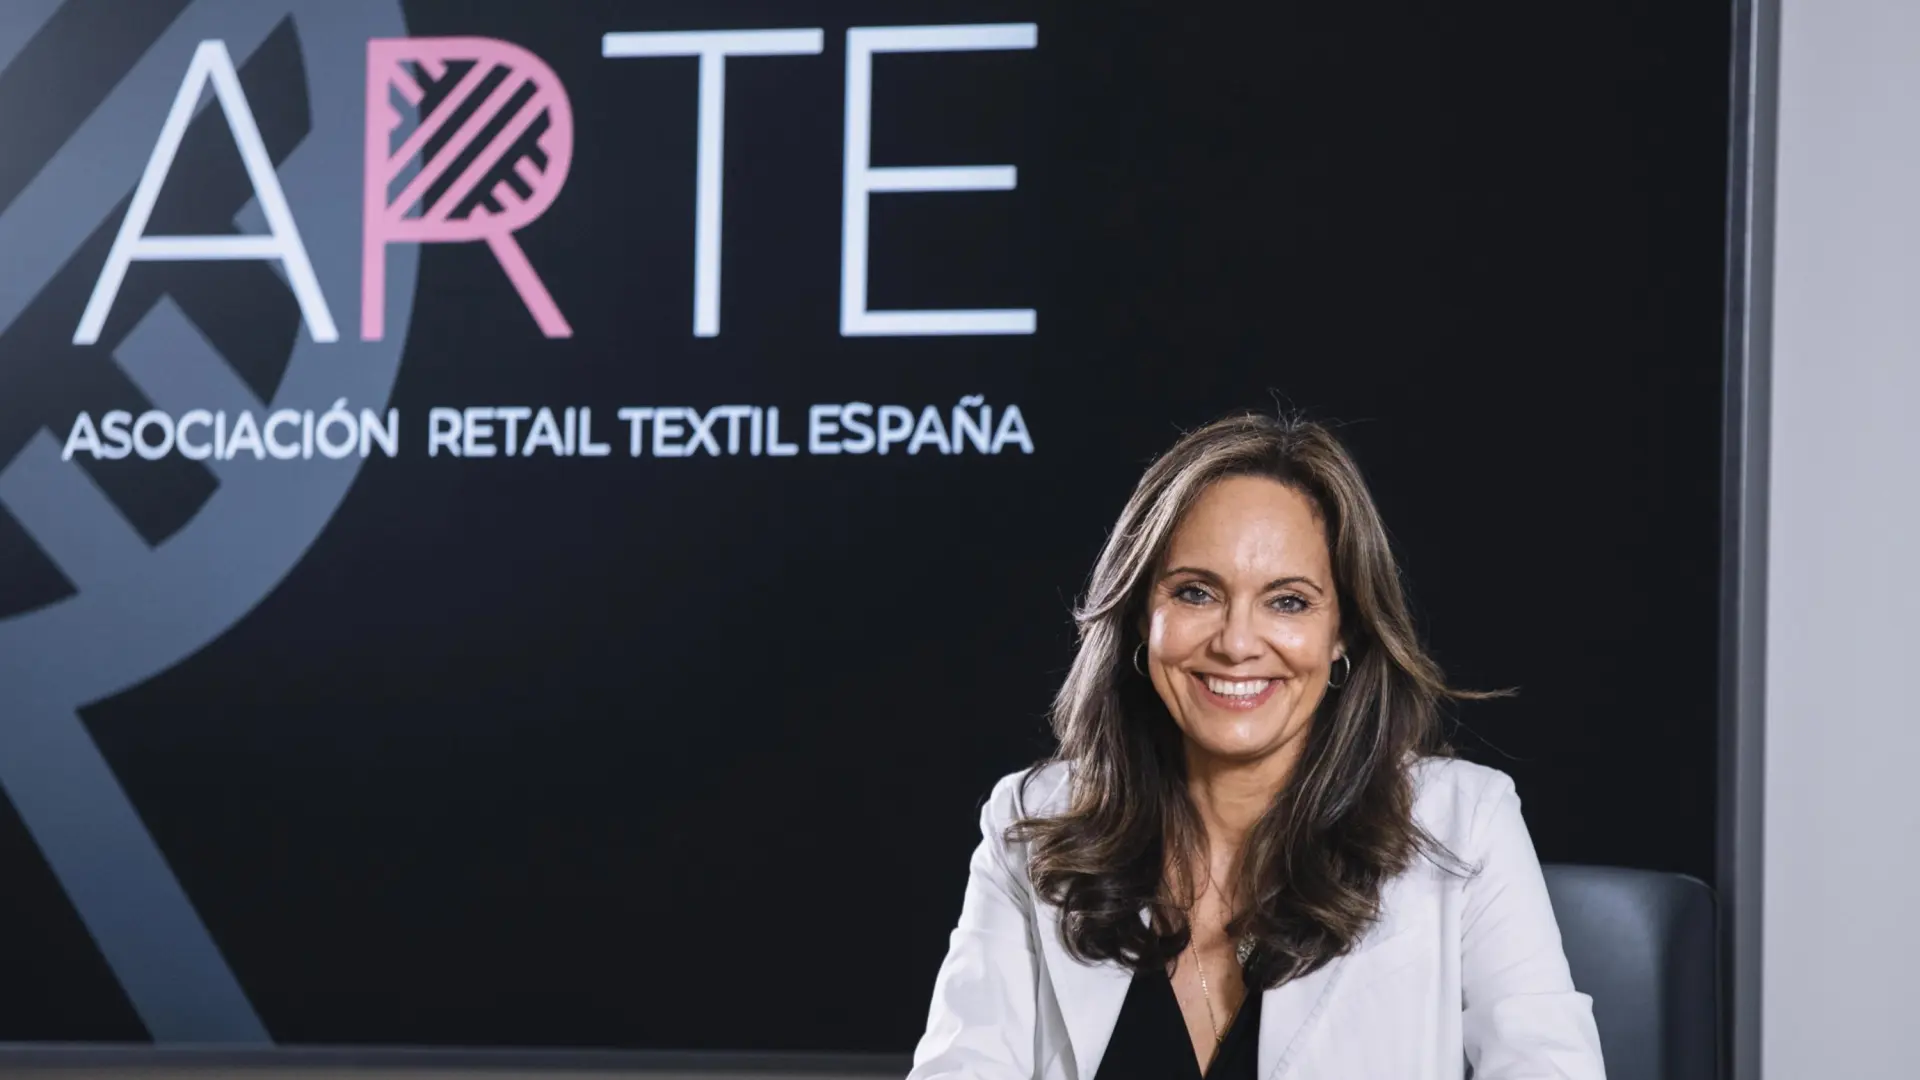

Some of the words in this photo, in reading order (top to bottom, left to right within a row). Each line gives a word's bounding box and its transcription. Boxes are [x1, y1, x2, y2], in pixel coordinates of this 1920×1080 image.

[72, 22, 1038, 345] ARTE
[62, 397, 399, 461] ASOCIACIÓN
[428, 408, 610, 457] RETAIL
[619, 407, 799, 457] TEXTIL
[808, 396, 1035, 455] ESPAÑA
